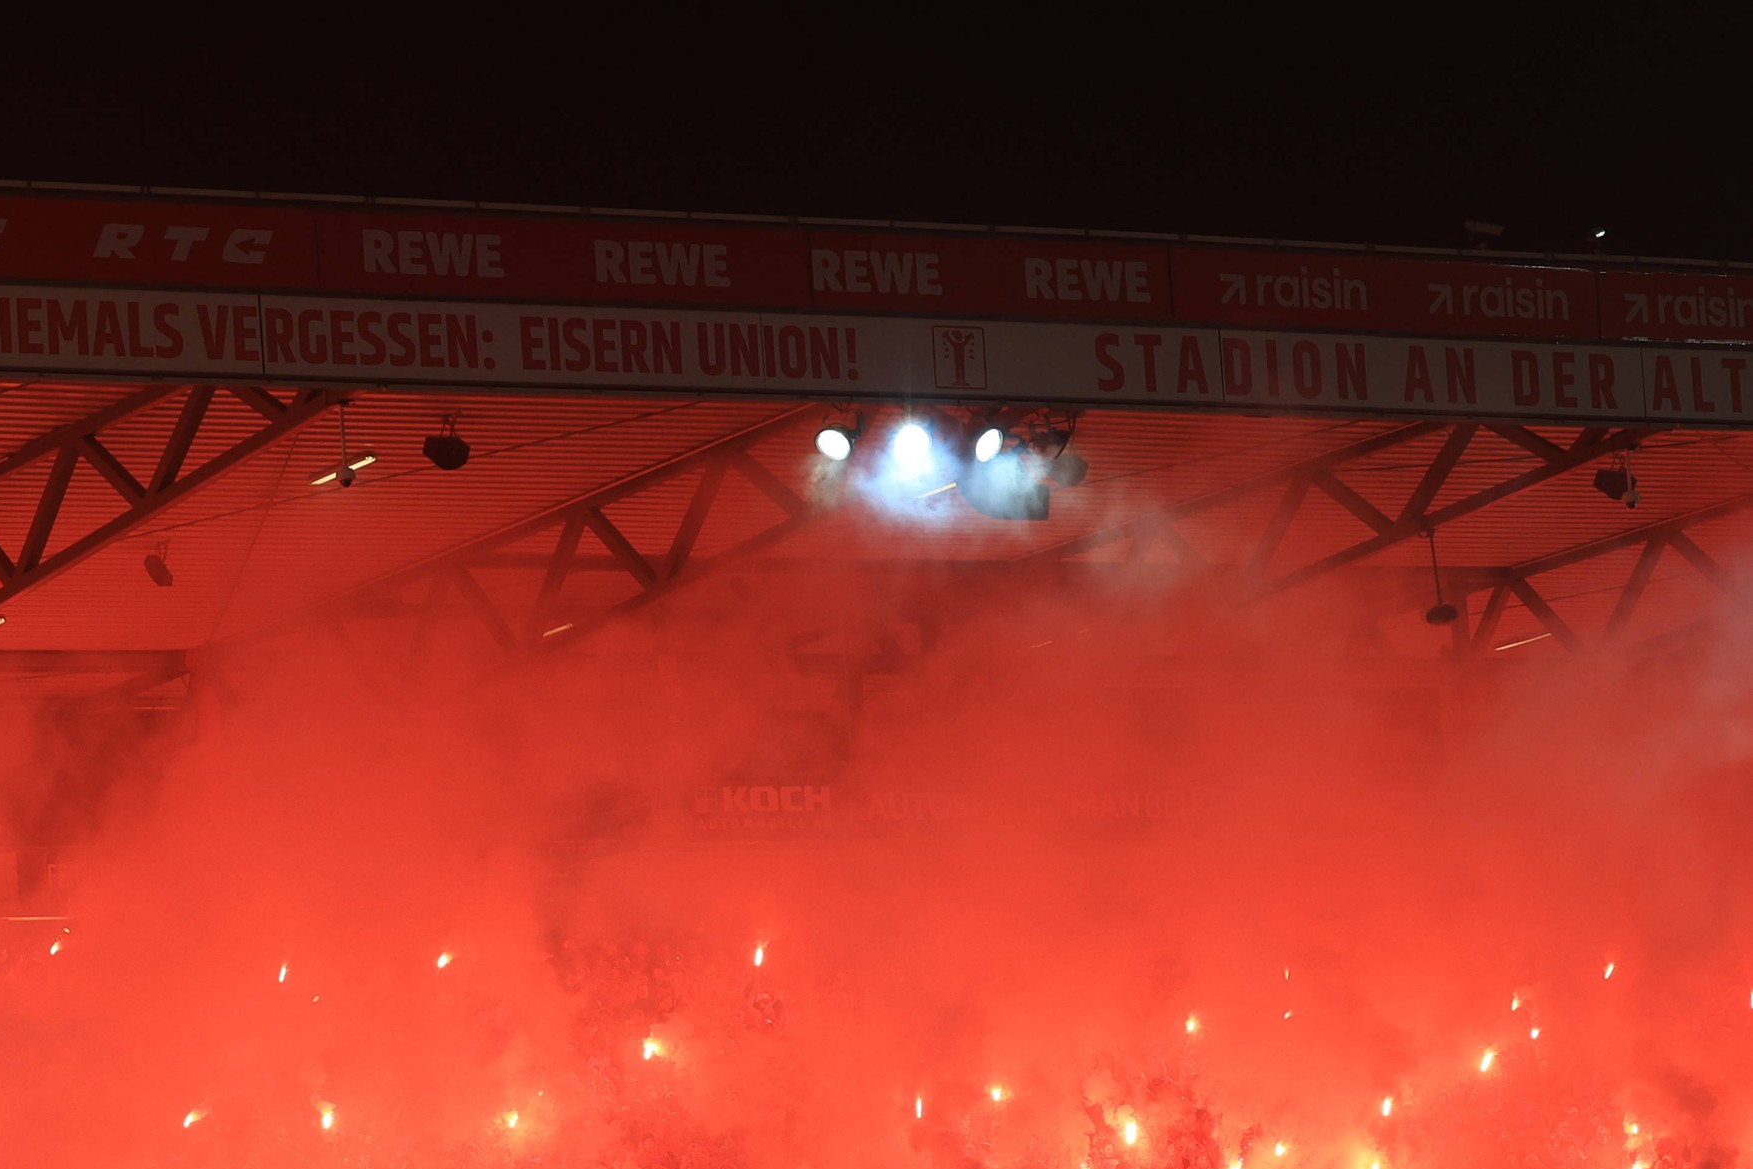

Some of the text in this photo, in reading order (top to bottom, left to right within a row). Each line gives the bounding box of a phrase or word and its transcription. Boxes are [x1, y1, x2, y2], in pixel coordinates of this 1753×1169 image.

[362, 228, 506, 278] REWE
[594, 240, 732, 288] REWE
[810, 249, 944, 296] REWE
[1024, 258, 1151, 304] REWE
[1256, 266, 1368, 311] raisin
[1463, 279, 1570, 322] raisin
[196, 304, 495, 371] VERGESSEN:
[520, 316, 684, 377] EISERN
[696, 321, 859, 382] UNION!
[1096, 332, 1746, 413] STADION AN DER ALT
